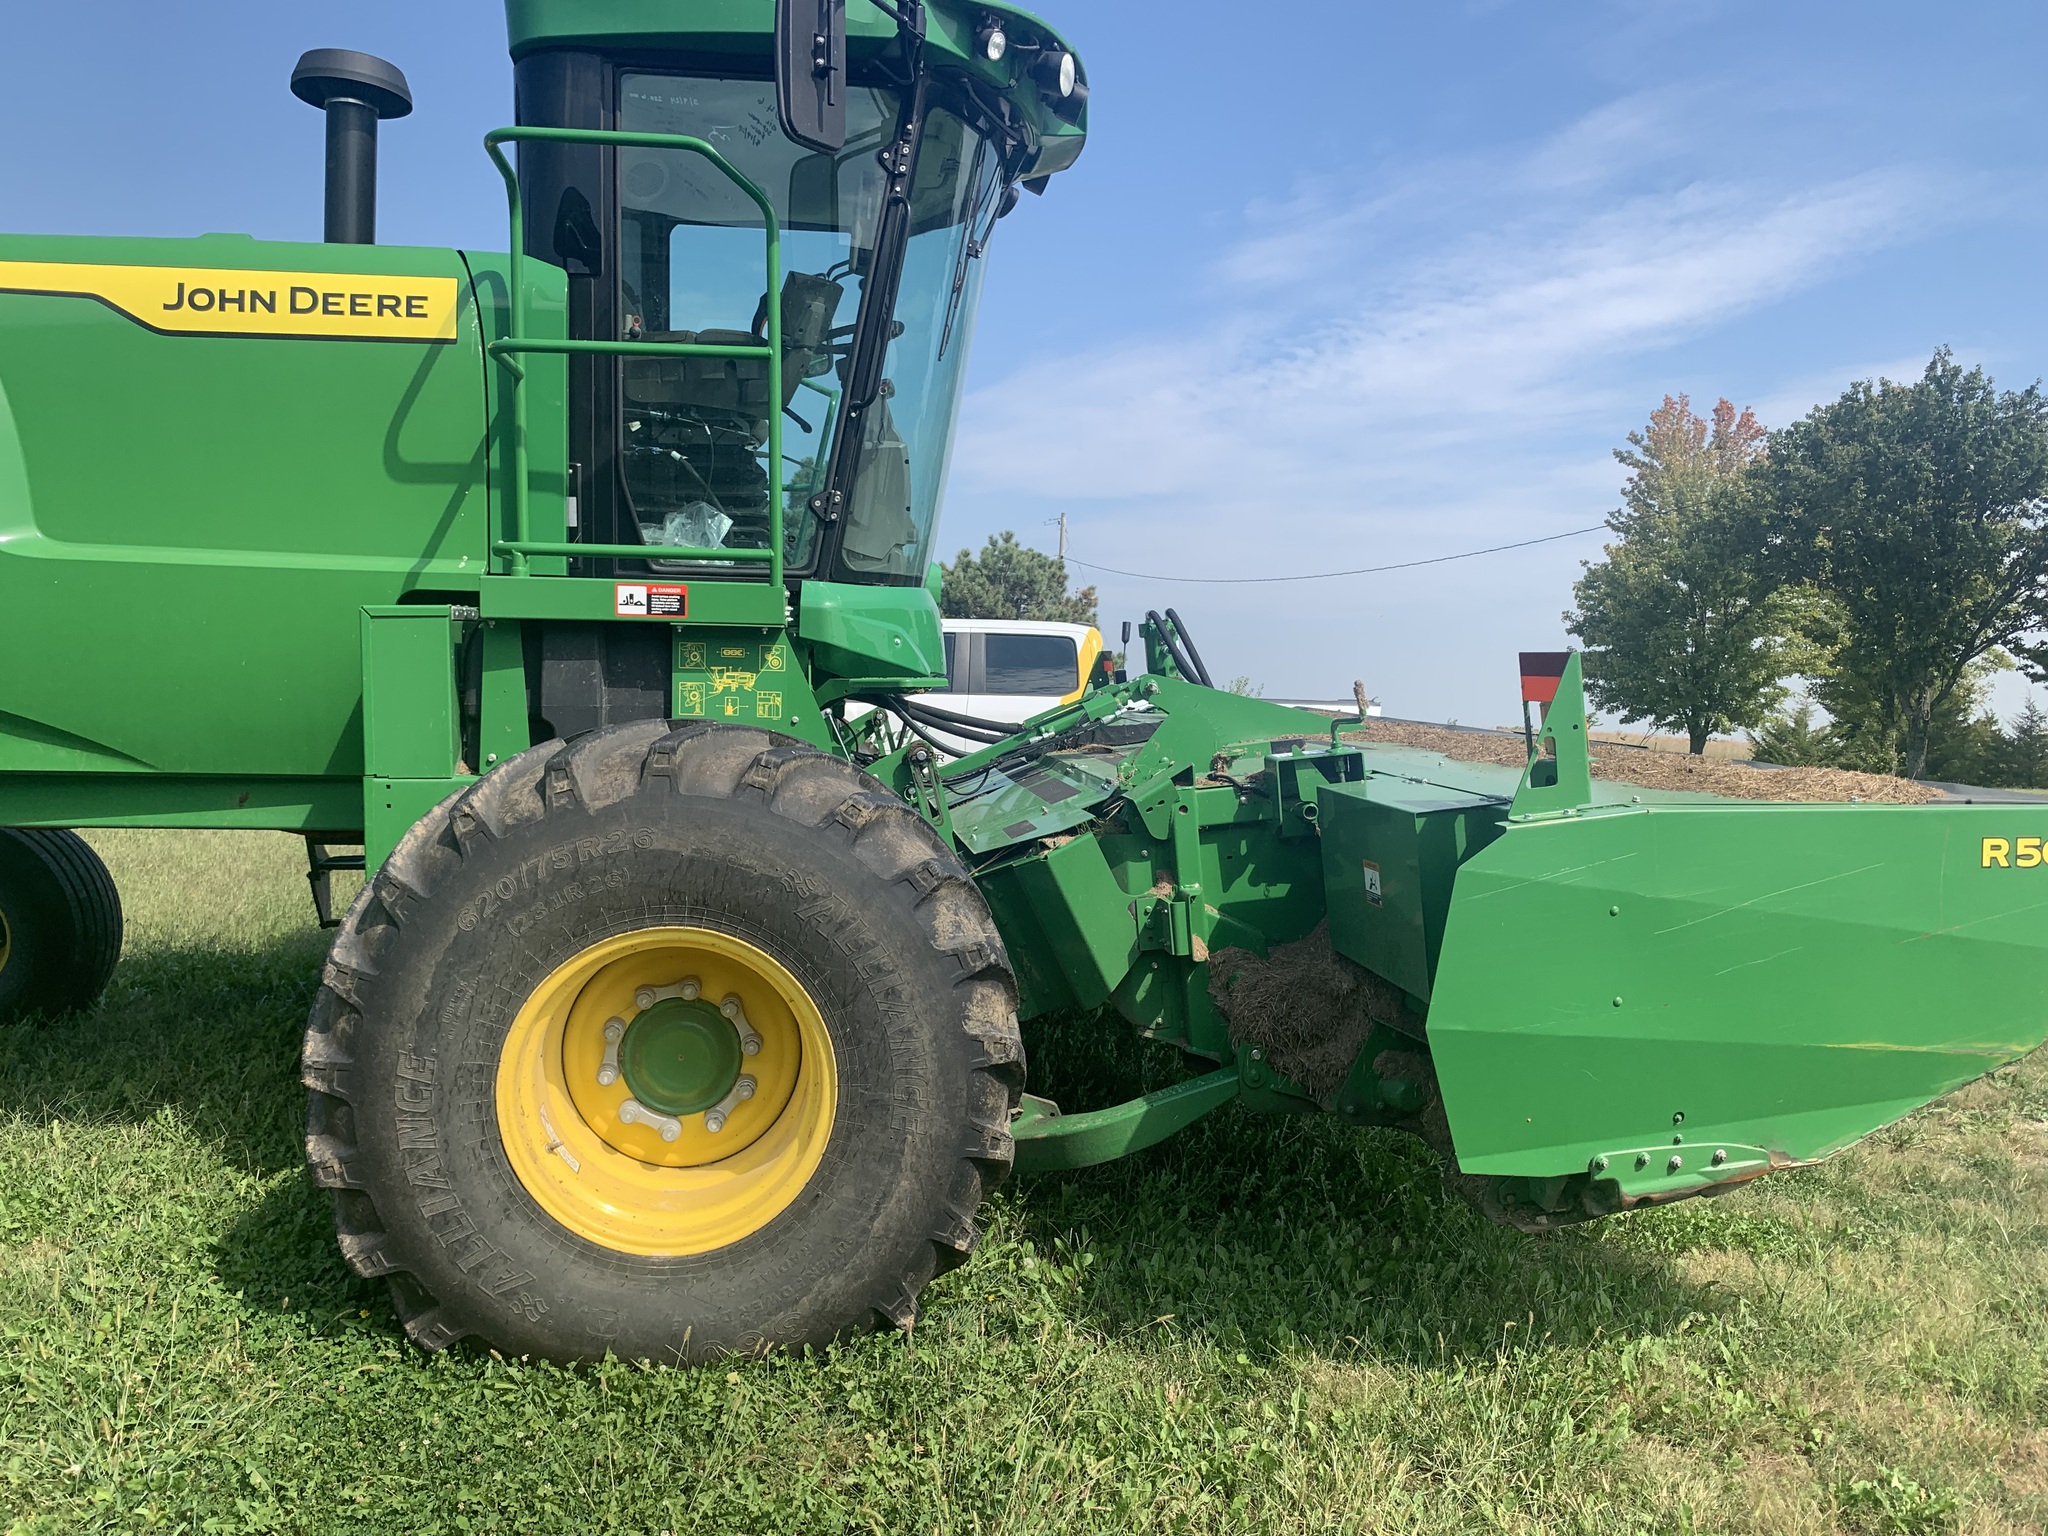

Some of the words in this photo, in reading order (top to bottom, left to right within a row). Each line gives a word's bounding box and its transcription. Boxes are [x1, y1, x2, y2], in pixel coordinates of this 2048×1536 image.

[163, 282, 276, 314] JOHN
[289, 286, 428, 318] DEERE
[458, 826, 655, 932] 620/75R26
[794, 891, 930, 1135] ALLIANCE
[394, 1049, 537, 1300] ALLIANCE
